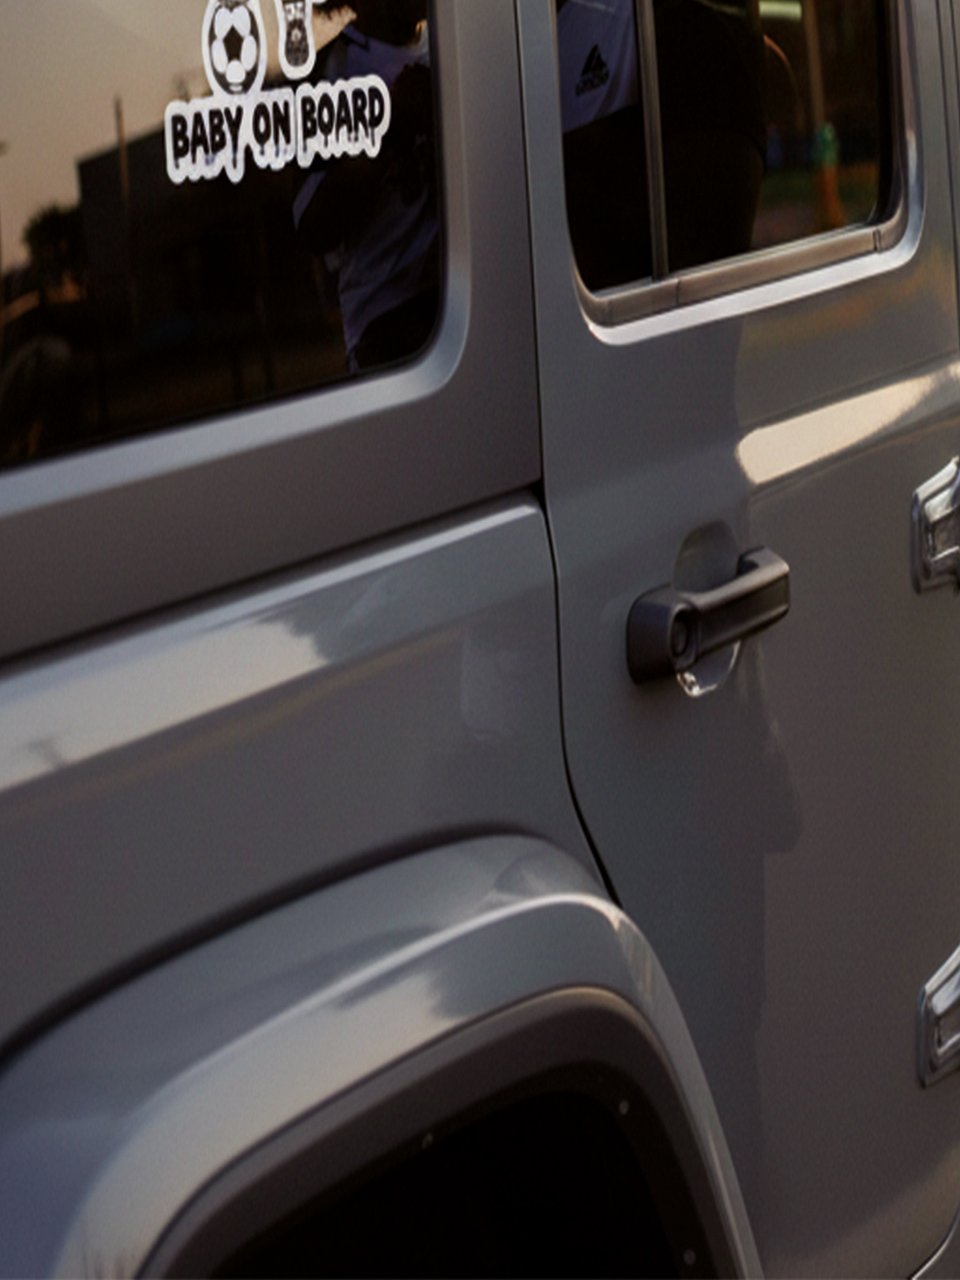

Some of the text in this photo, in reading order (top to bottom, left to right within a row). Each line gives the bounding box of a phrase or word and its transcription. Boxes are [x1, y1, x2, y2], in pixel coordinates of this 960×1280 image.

[171, 86, 385, 170] BABY ON BOARD
